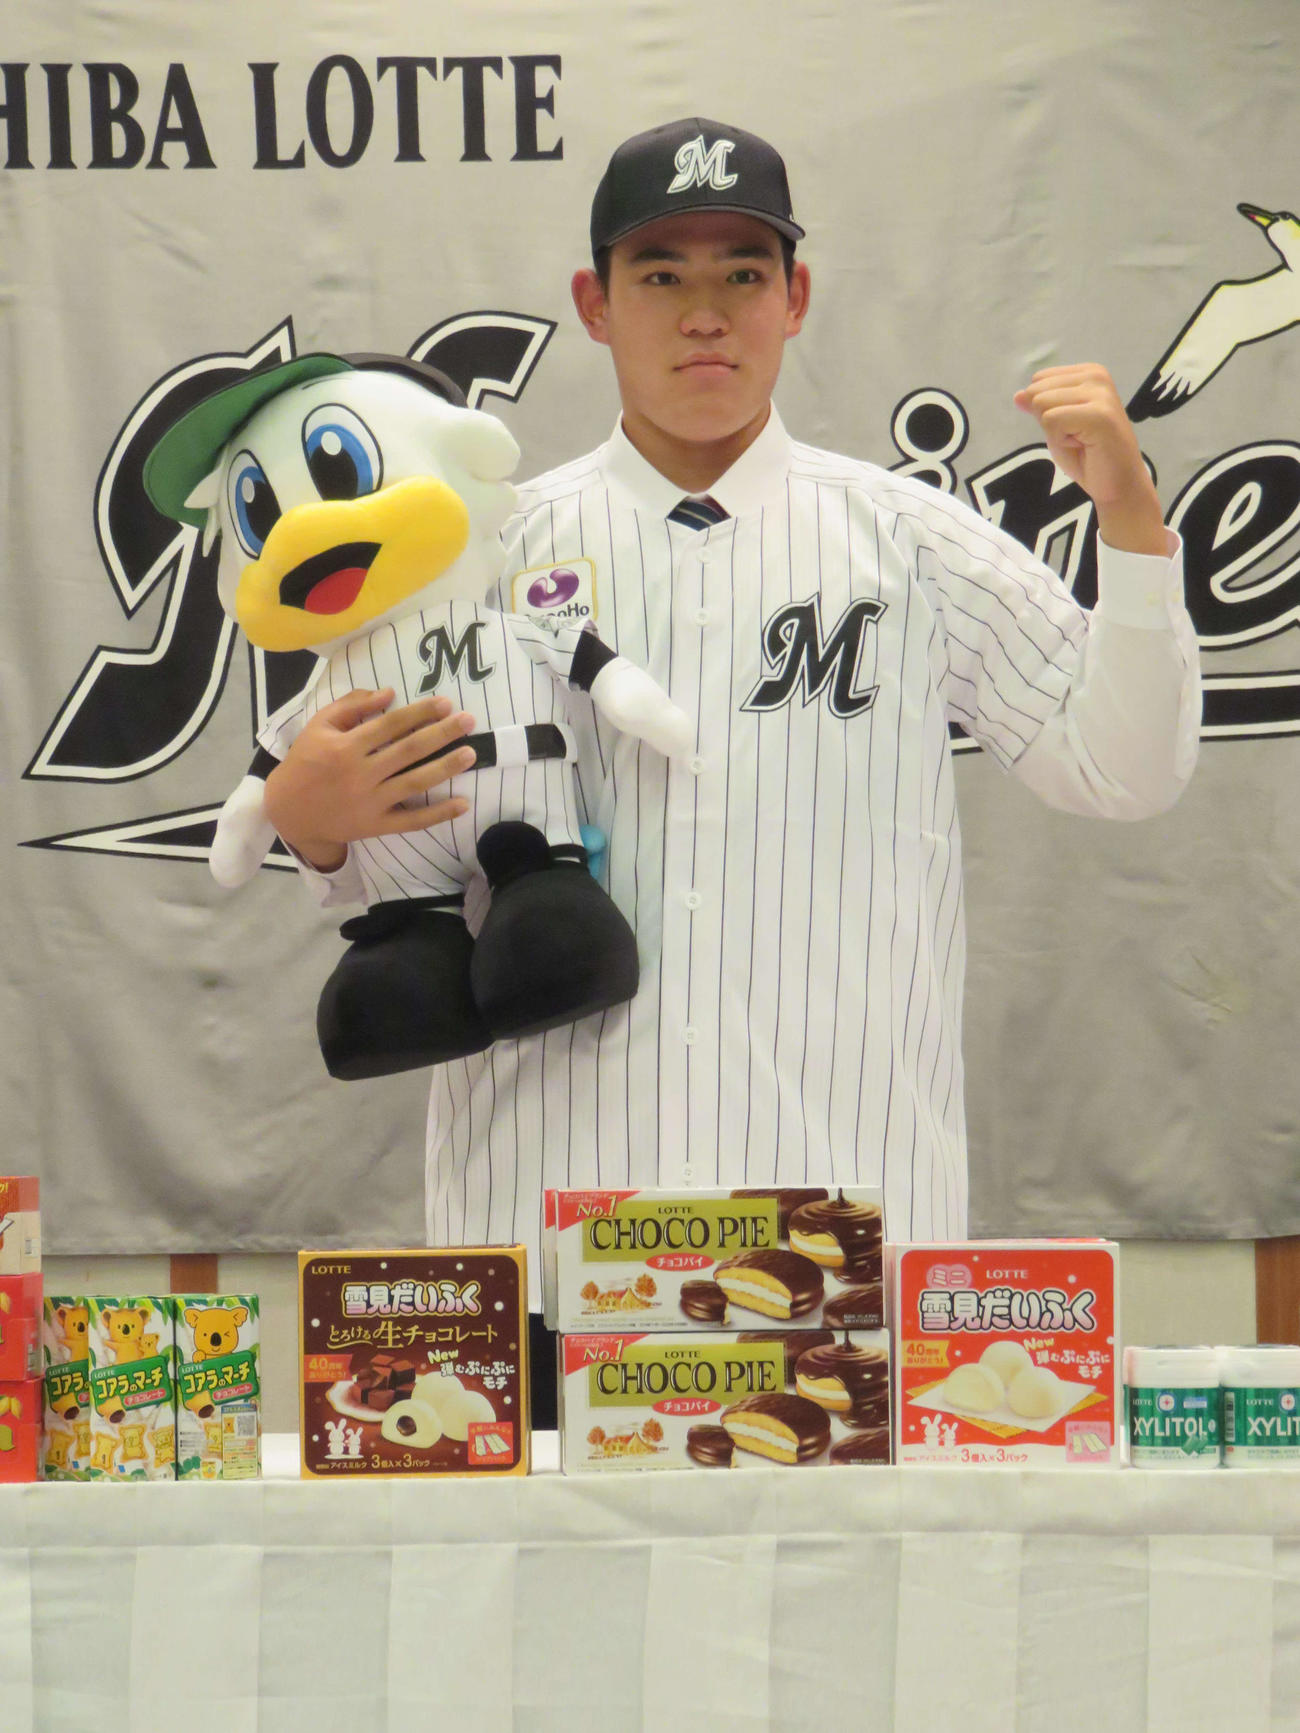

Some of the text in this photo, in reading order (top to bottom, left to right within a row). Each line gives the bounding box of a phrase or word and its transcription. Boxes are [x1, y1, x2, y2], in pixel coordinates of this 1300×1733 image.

[247, 54, 564, 170] LOTTE
[665, 134, 739, 194] M
[415, 619, 497, 697] M
[740, 592, 889, 720] M
[577, 1195, 617, 1218] No.1
[657, 1206, 694, 1214] LOTTE
[590, 1216, 771, 1250] CHOCO PIE
[311, 1265, 351, 1275] LOTTE
[933, 1269, 964, 1285] ミニ
[986, 1269, 1029, 1279] LOTTE
[341, 1279, 481, 1318] 雪見だいふく
[919, 1287, 1098, 1333] 雪見だいふく
[427, 1349, 459, 1364] New
[583, 1339, 623, 1363] No.1
[664, 1351, 700, 1359] LOTTE
[97, 1367, 163, 1399] コアラのマーチ
[184, 1362, 250, 1393] コアラのマーチ
[596, 1360, 777, 1395] CHOCO PIE
[1133, 1416, 1208, 1438] XYLITOL
